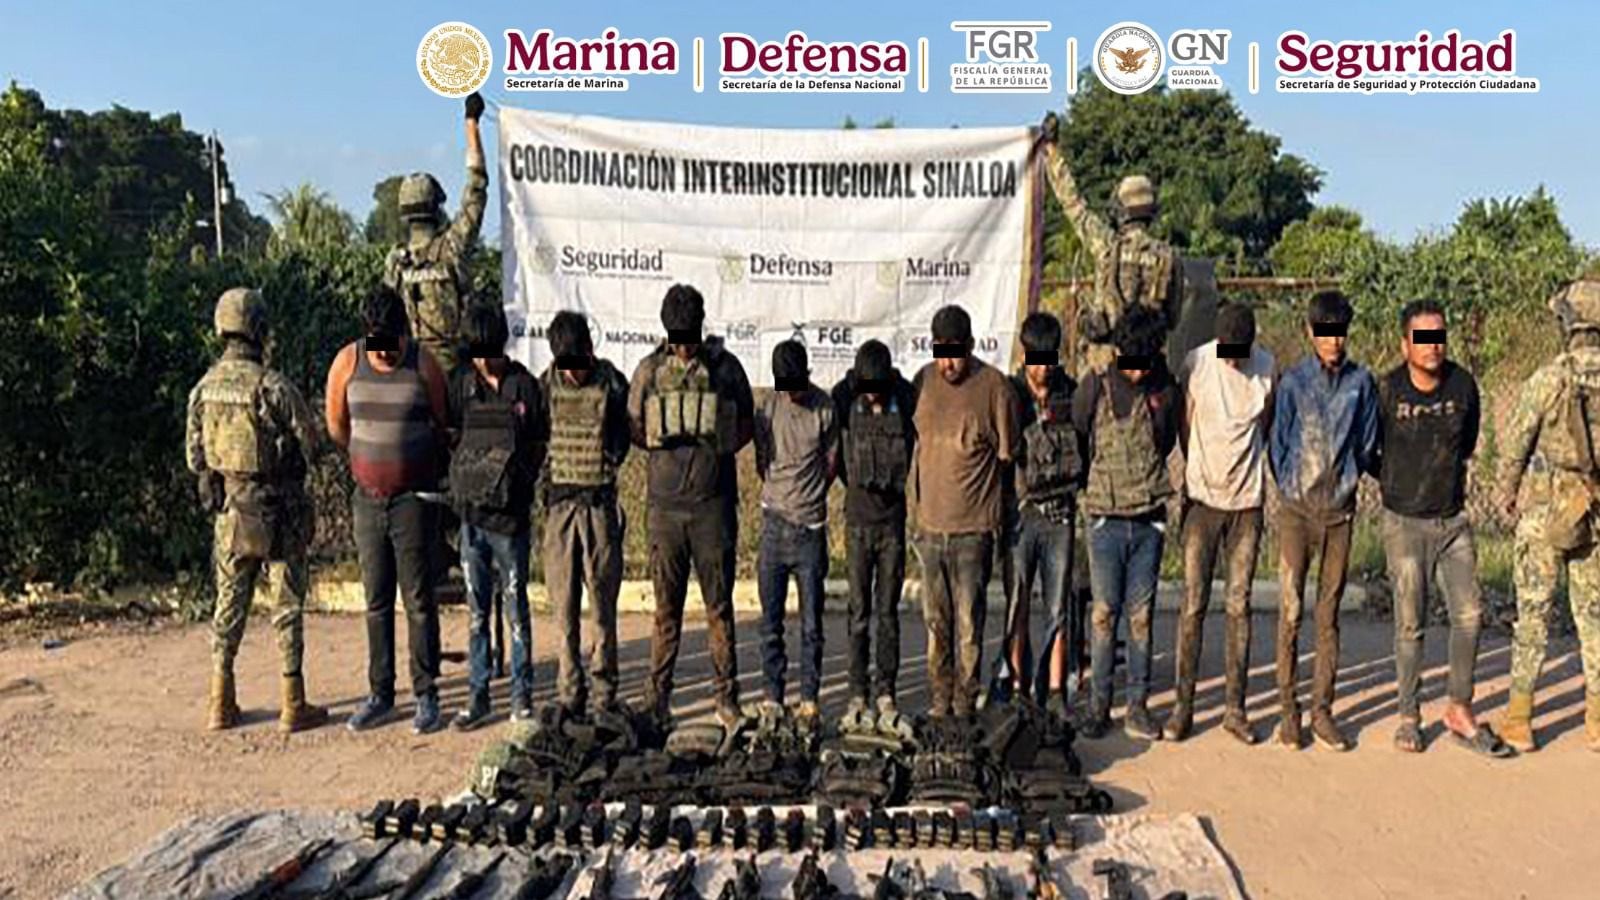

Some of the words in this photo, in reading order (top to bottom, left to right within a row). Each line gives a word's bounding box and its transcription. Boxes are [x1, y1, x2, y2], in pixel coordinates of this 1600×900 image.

[510, 144, 676, 193] COORDINACIÓN
[683, 159, 916, 198] INTERINSTITUCIONAL
[923, 160, 1017, 198] SINALOA
[561, 245, 664, 272] Seguridad
[749, 253, 833, 277] Defensa
[906, 257, 971, 278] Marina
[818, 327, 853, 345] FGE
